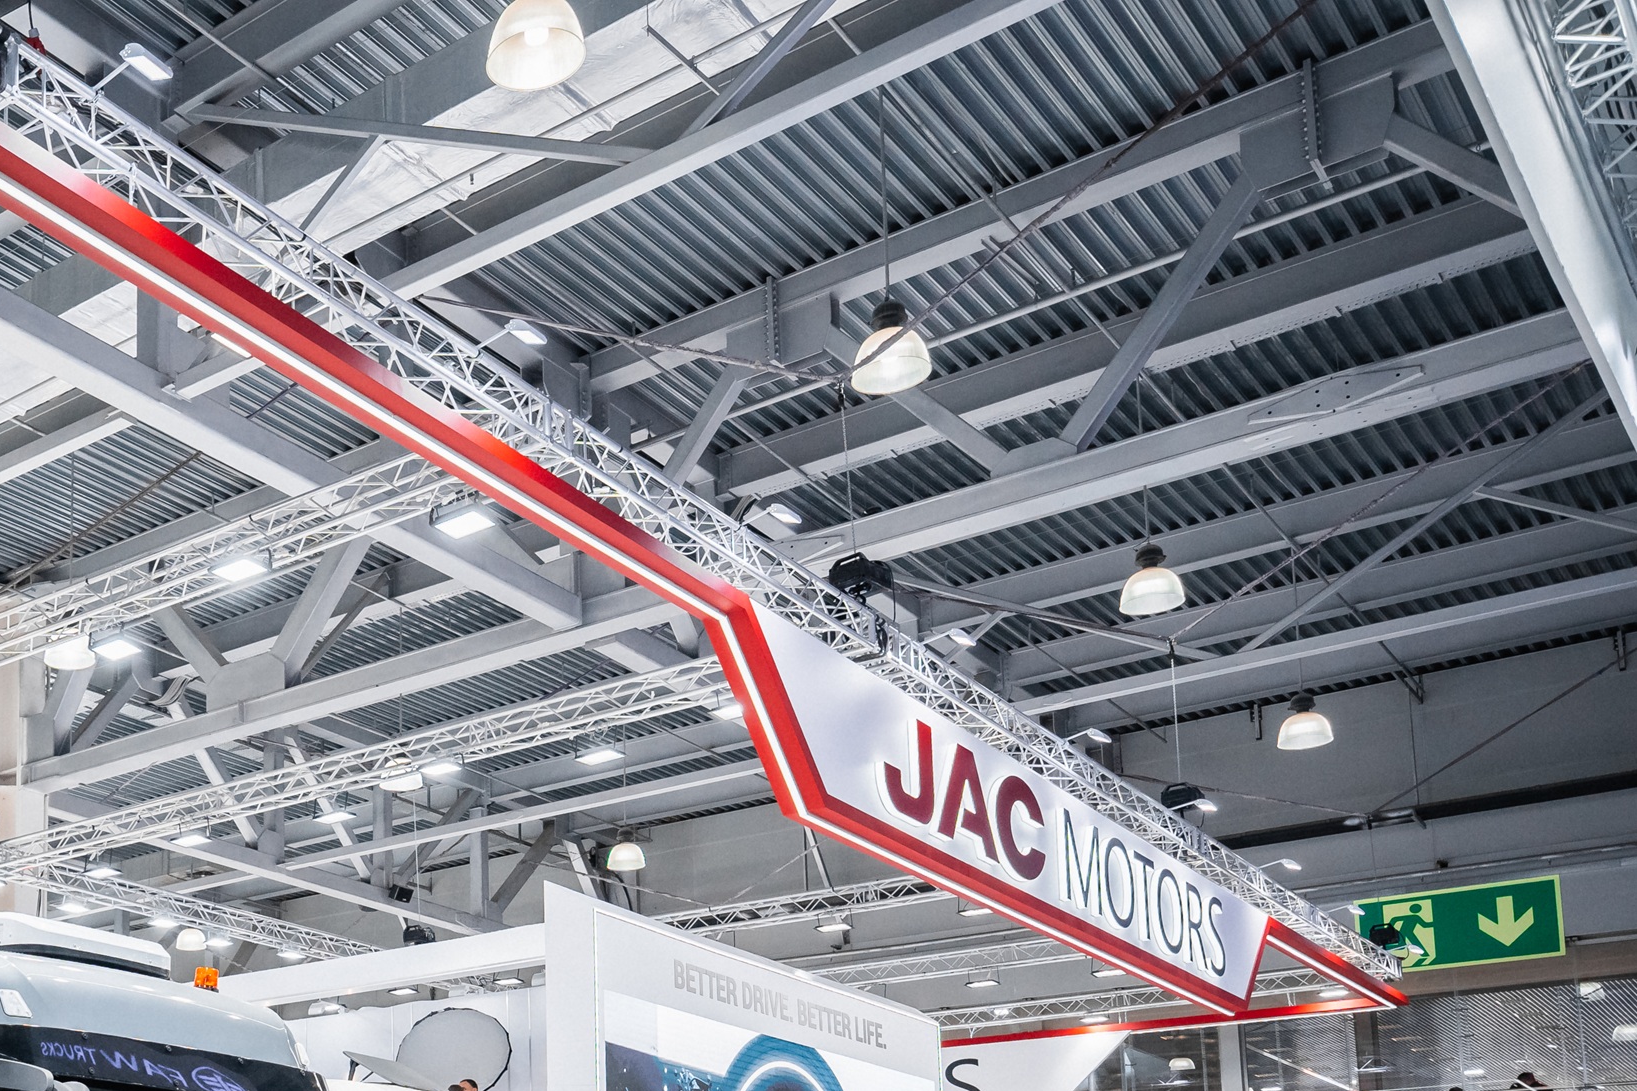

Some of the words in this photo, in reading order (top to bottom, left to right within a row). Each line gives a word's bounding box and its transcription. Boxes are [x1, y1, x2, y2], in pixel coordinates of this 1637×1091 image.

[879, 719, 1046, 880] JAC
[1059, 808, 1226, 977] MOTORS
[673, 958, 739, 1007] BETTER
[741, 981, 794, 1023] DRIVE.
[797, 998, 852, 1040] BETTER
[854, 1016, 888, 1050] LIFE.
